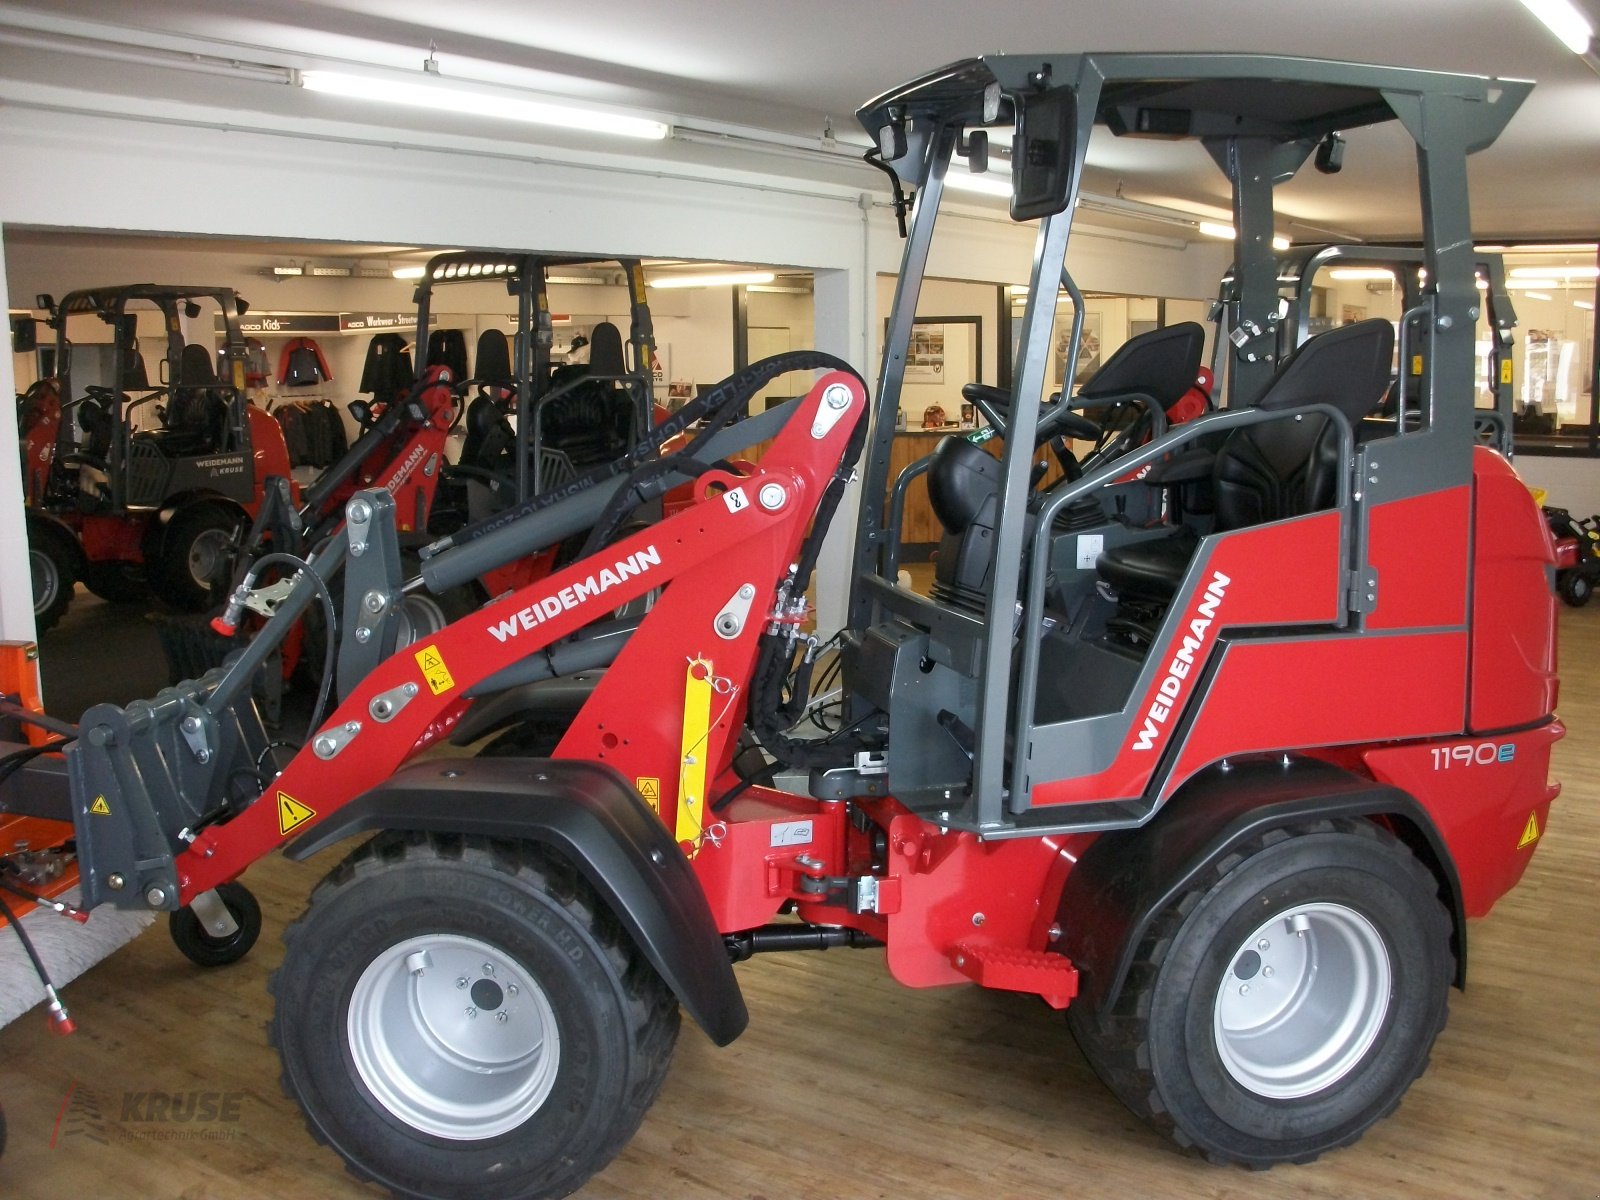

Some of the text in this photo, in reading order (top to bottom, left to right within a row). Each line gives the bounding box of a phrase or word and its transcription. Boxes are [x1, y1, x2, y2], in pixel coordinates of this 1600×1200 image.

[240, 319, 281, 331] AGCO Kids
[347, 321, 365, 329] AGCO
[398, 313, 420, 325] Streetw
[196, 457, 244, 468] WEIDEMANN
[219, 466, 244, 475] KRUSE
[487, 545, 662, 642] WEIDEMANN
[1132, 571, 1231, 750] WEIDEMANN
[1431, 743, 1515, 770] 1190e
[486, 886, 552, 930] POWER
